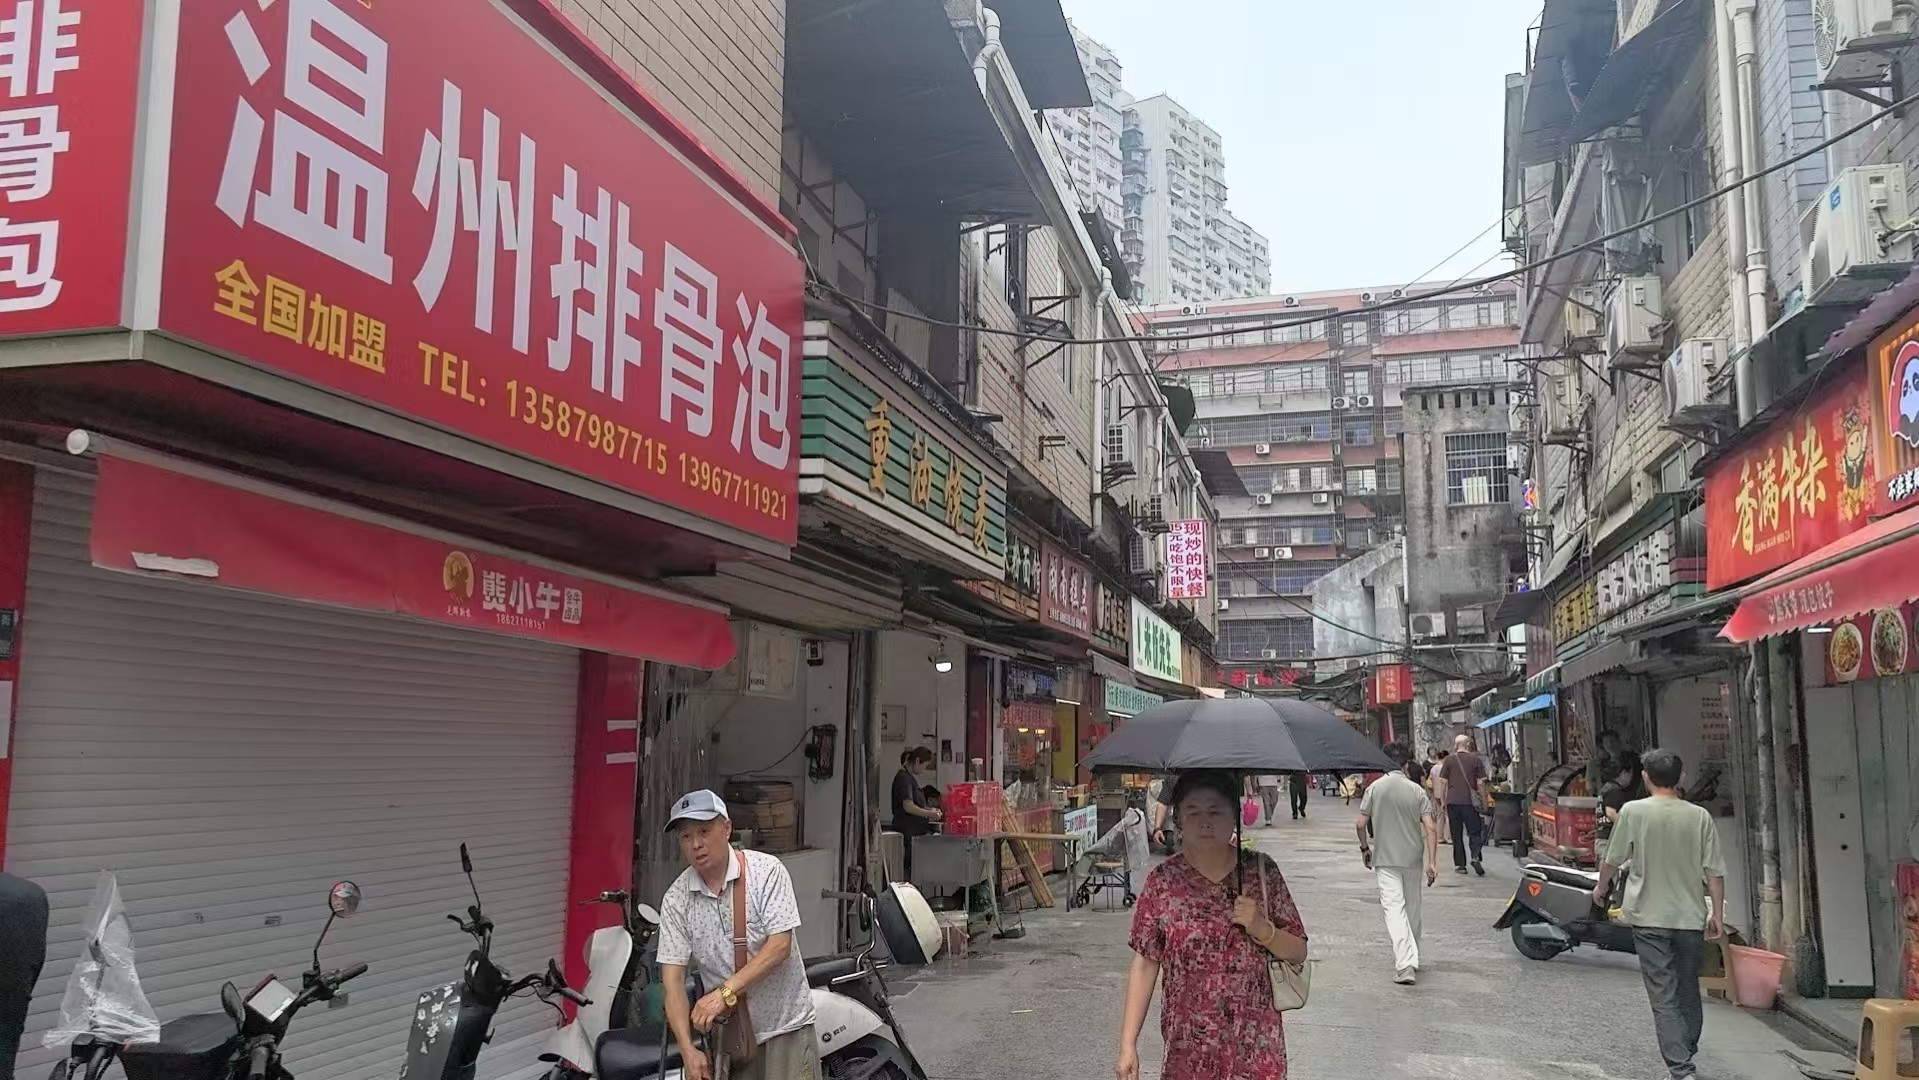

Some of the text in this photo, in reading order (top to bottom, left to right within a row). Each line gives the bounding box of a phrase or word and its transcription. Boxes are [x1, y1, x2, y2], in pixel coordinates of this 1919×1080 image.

[214, 0, 792, 471] 温州排骨泡
[213, 259, 788, 522] 全国加盟 TEL: 13587987715 13967711921
[1731, 416, 1829, 555] 香满牛杂
[1169, 523, 1185, 598] 15元吃饱不限量
[1184, 522, 1203, 597] 现炒的快餐
[681, 800, 690, 810] B
